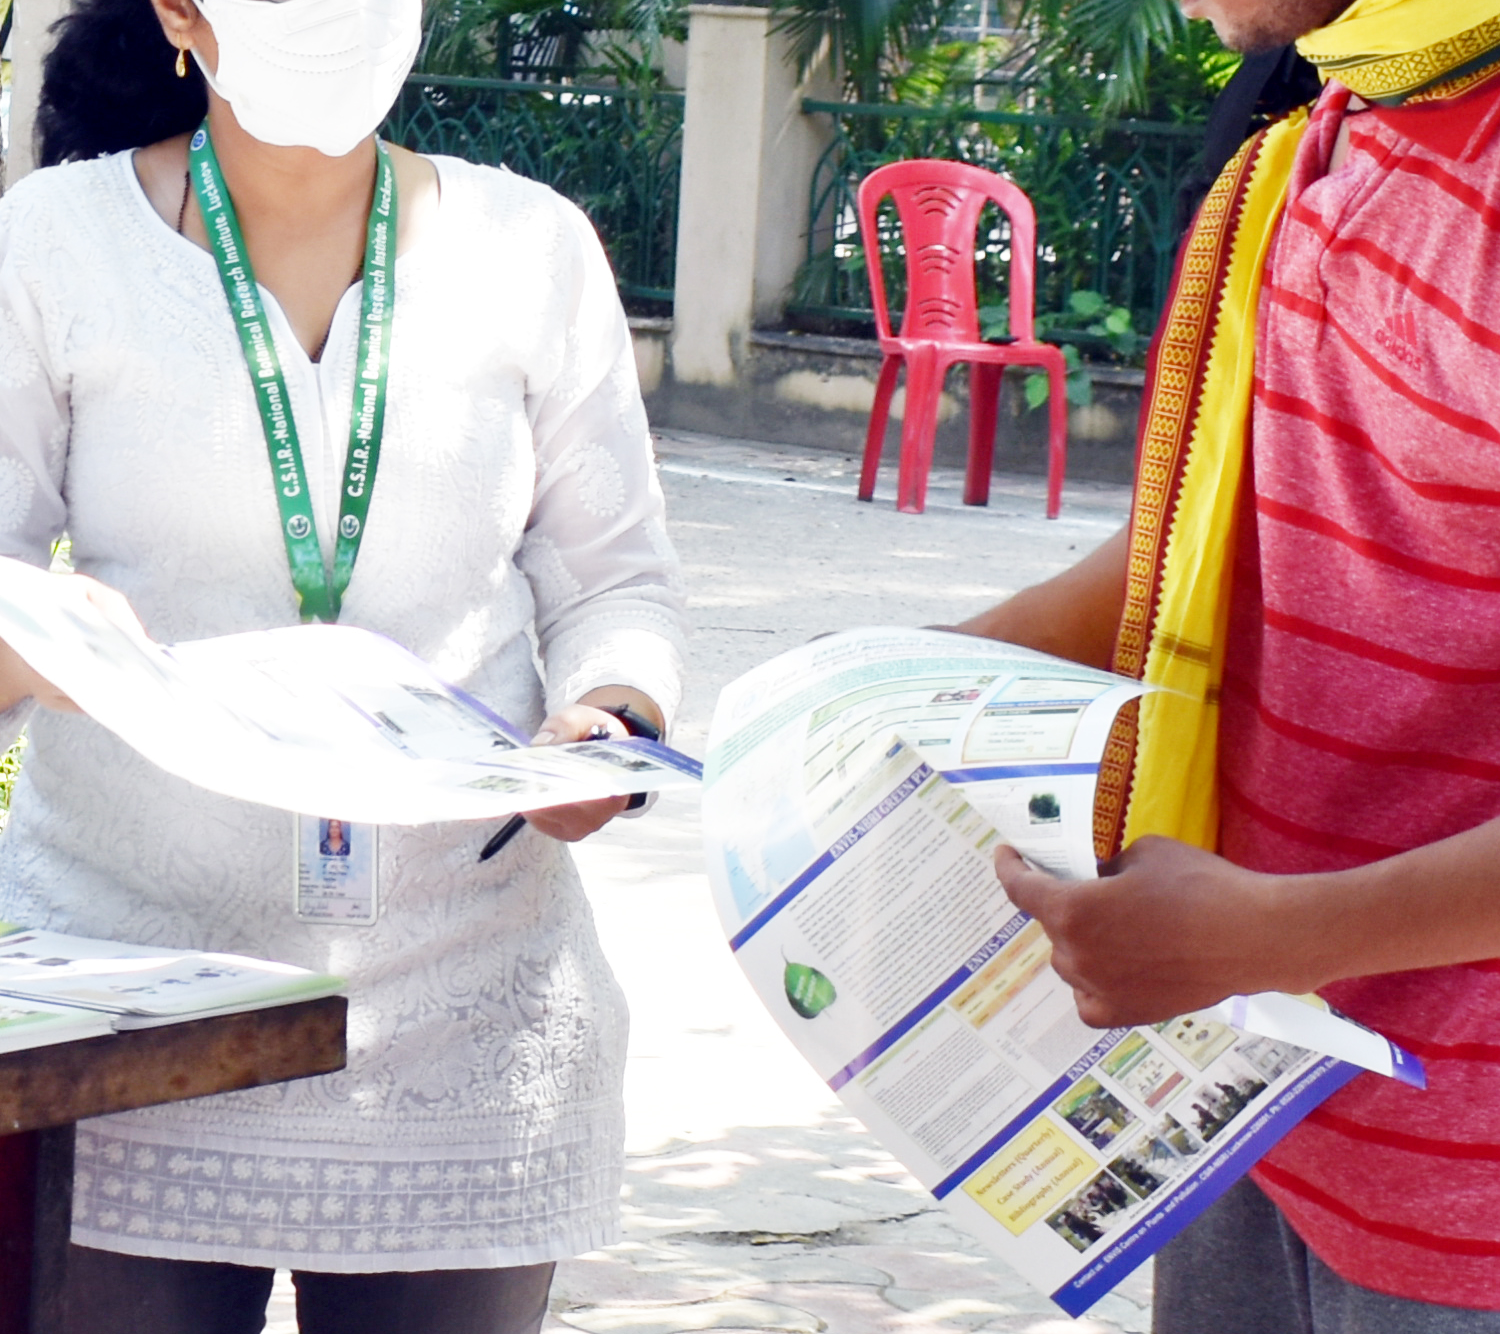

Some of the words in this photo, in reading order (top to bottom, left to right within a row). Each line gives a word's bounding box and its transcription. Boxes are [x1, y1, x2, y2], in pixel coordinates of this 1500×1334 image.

[199, 161, 222, 212] Lucknow
[228, 267, 257, 320] Research
[367, 269, 387, 322] Research
[244, 323, 276, 379] Botanical
[363, 324, 382, 380] Botanical
[829, 810, 883, 859] ENVIS-NBRI
[879, 784, 916, 817] GREEN
[965, 913, 1027, 973] ENVIS-NBRI
